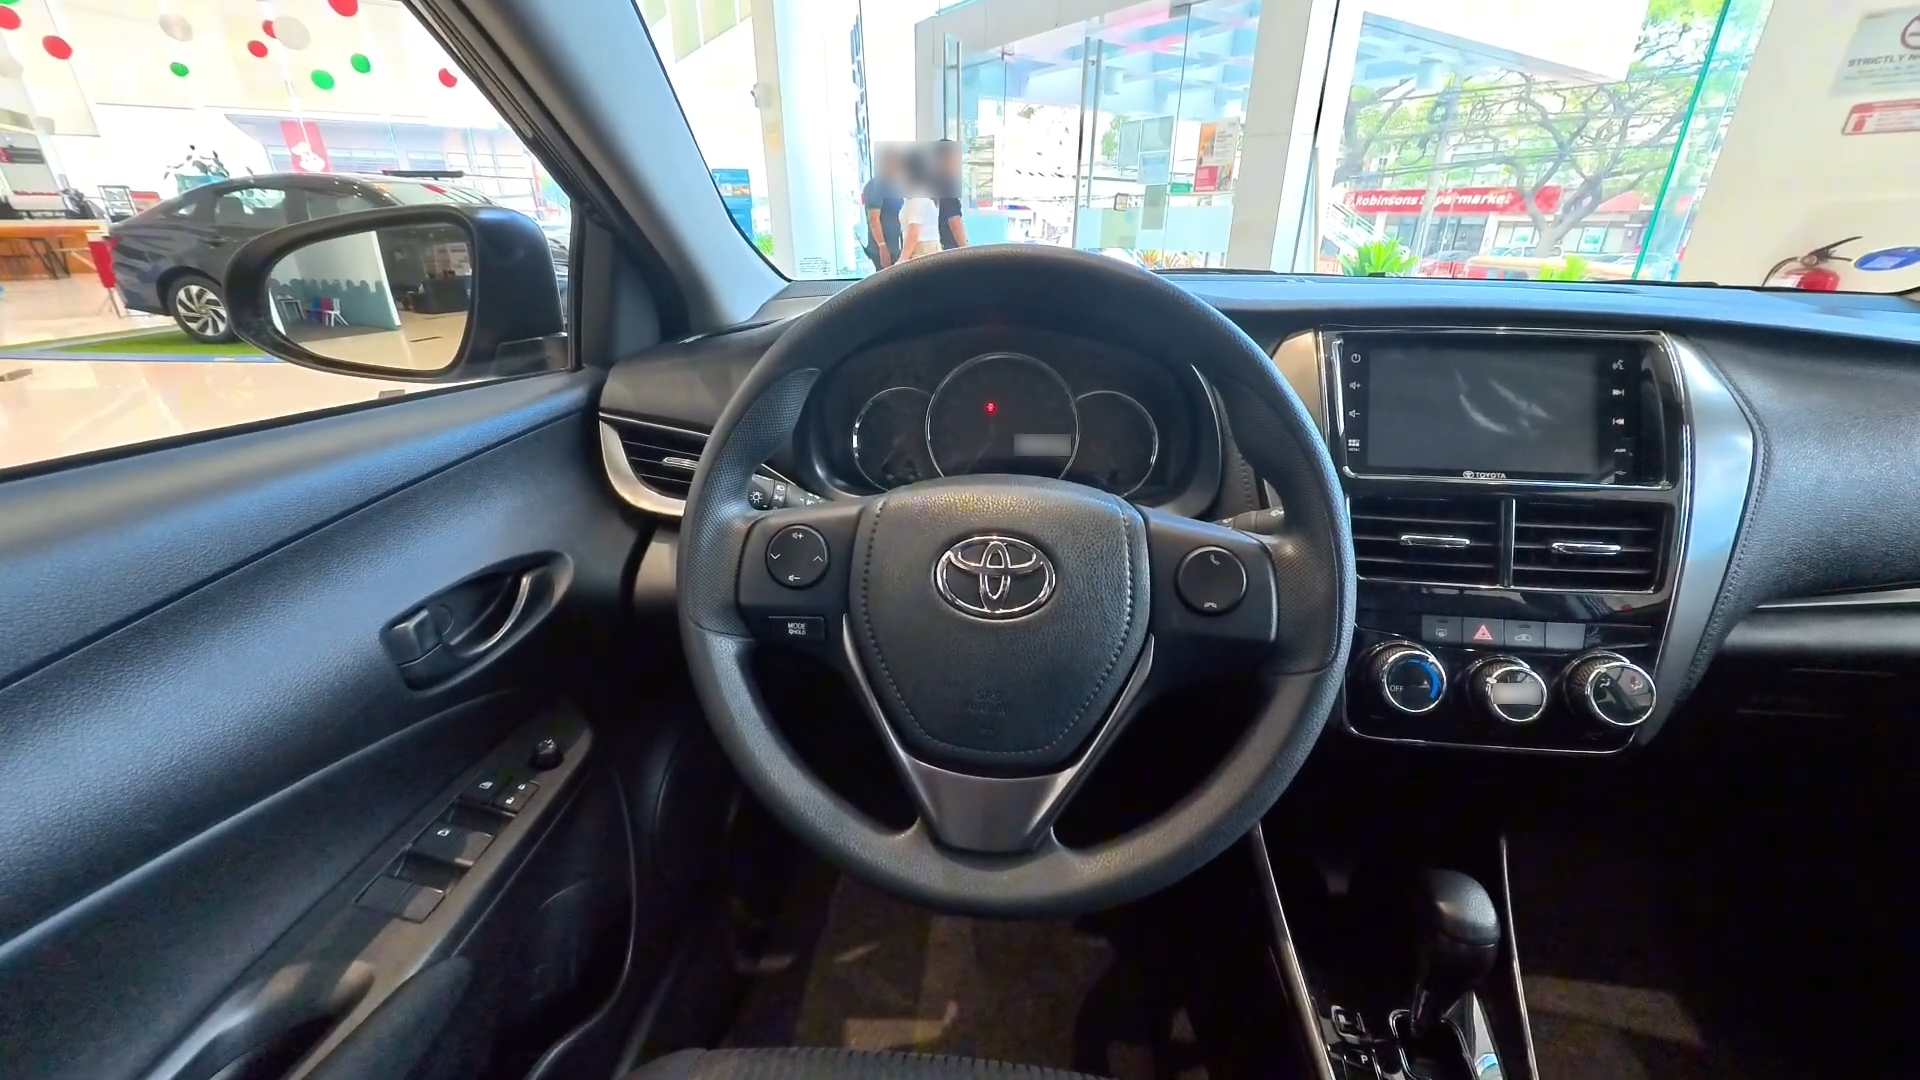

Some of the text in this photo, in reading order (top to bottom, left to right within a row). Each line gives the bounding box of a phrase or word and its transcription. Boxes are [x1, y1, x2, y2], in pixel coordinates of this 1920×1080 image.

[1847, 54, 1907, 67] STRICTLY
[1355, 193, 1419, 206] Robinsons
[1474, 471, 1507, 479] TOYOTA
[787, 622, 806, 630] MODE
[1389, 684, 1404, 692] OFF
[1360, 1054, 1369, 1065] P
